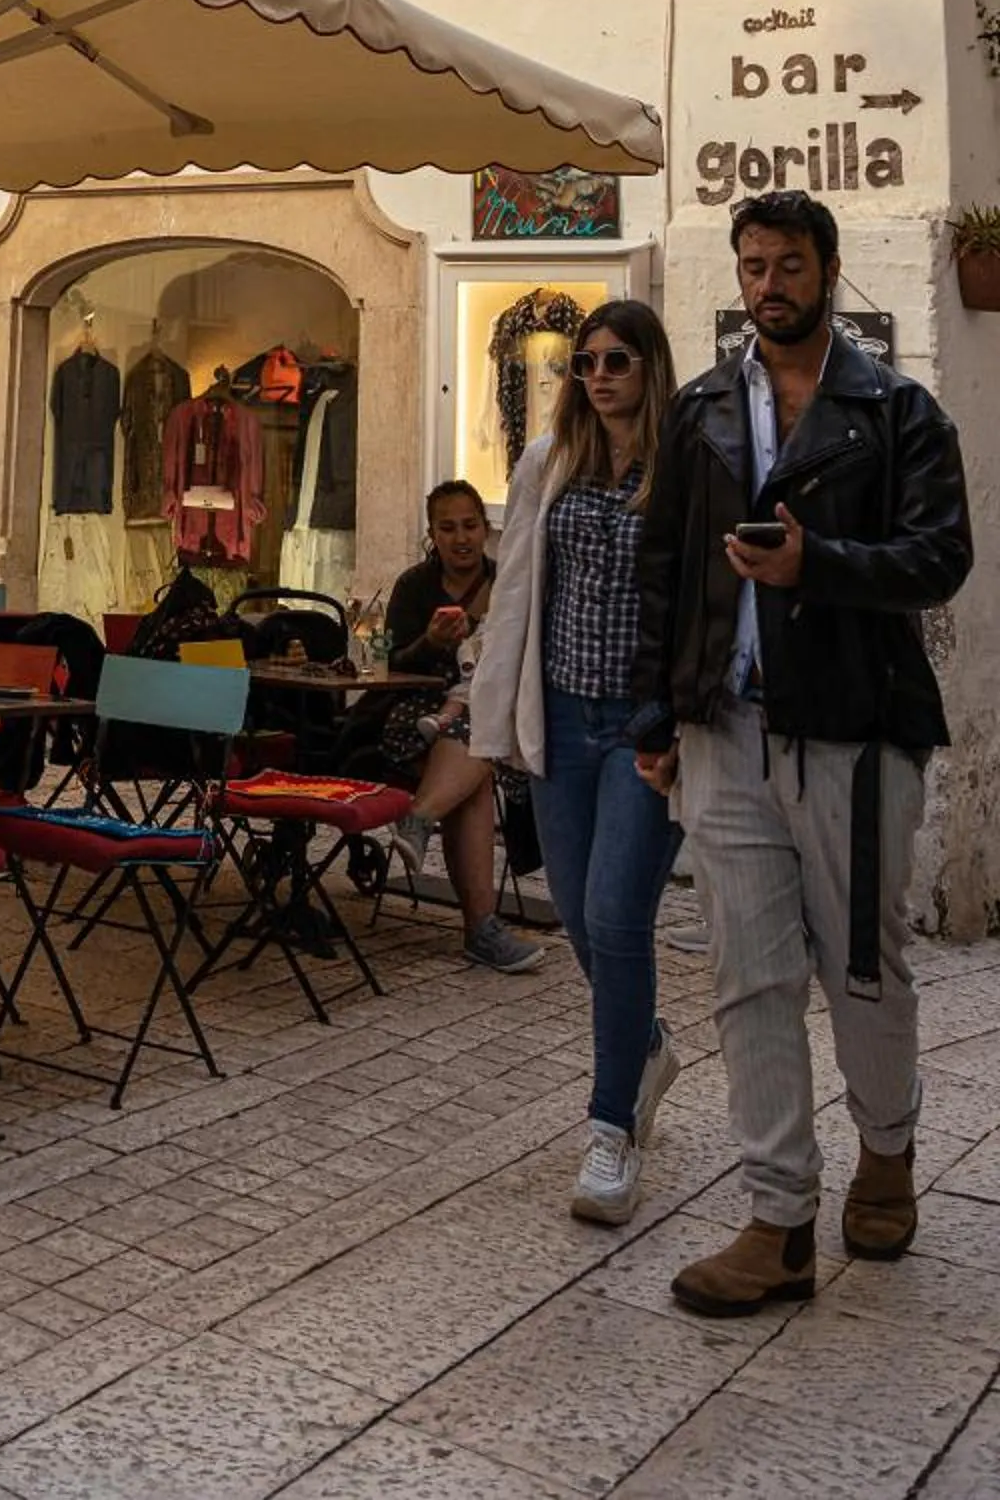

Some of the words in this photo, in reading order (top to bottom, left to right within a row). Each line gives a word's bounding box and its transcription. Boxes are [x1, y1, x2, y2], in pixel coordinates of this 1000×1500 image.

[743, 7, 816, 33] cocktail
[731, 53, 866, 99] bar
[696, 122, 905, 206] gorilla
